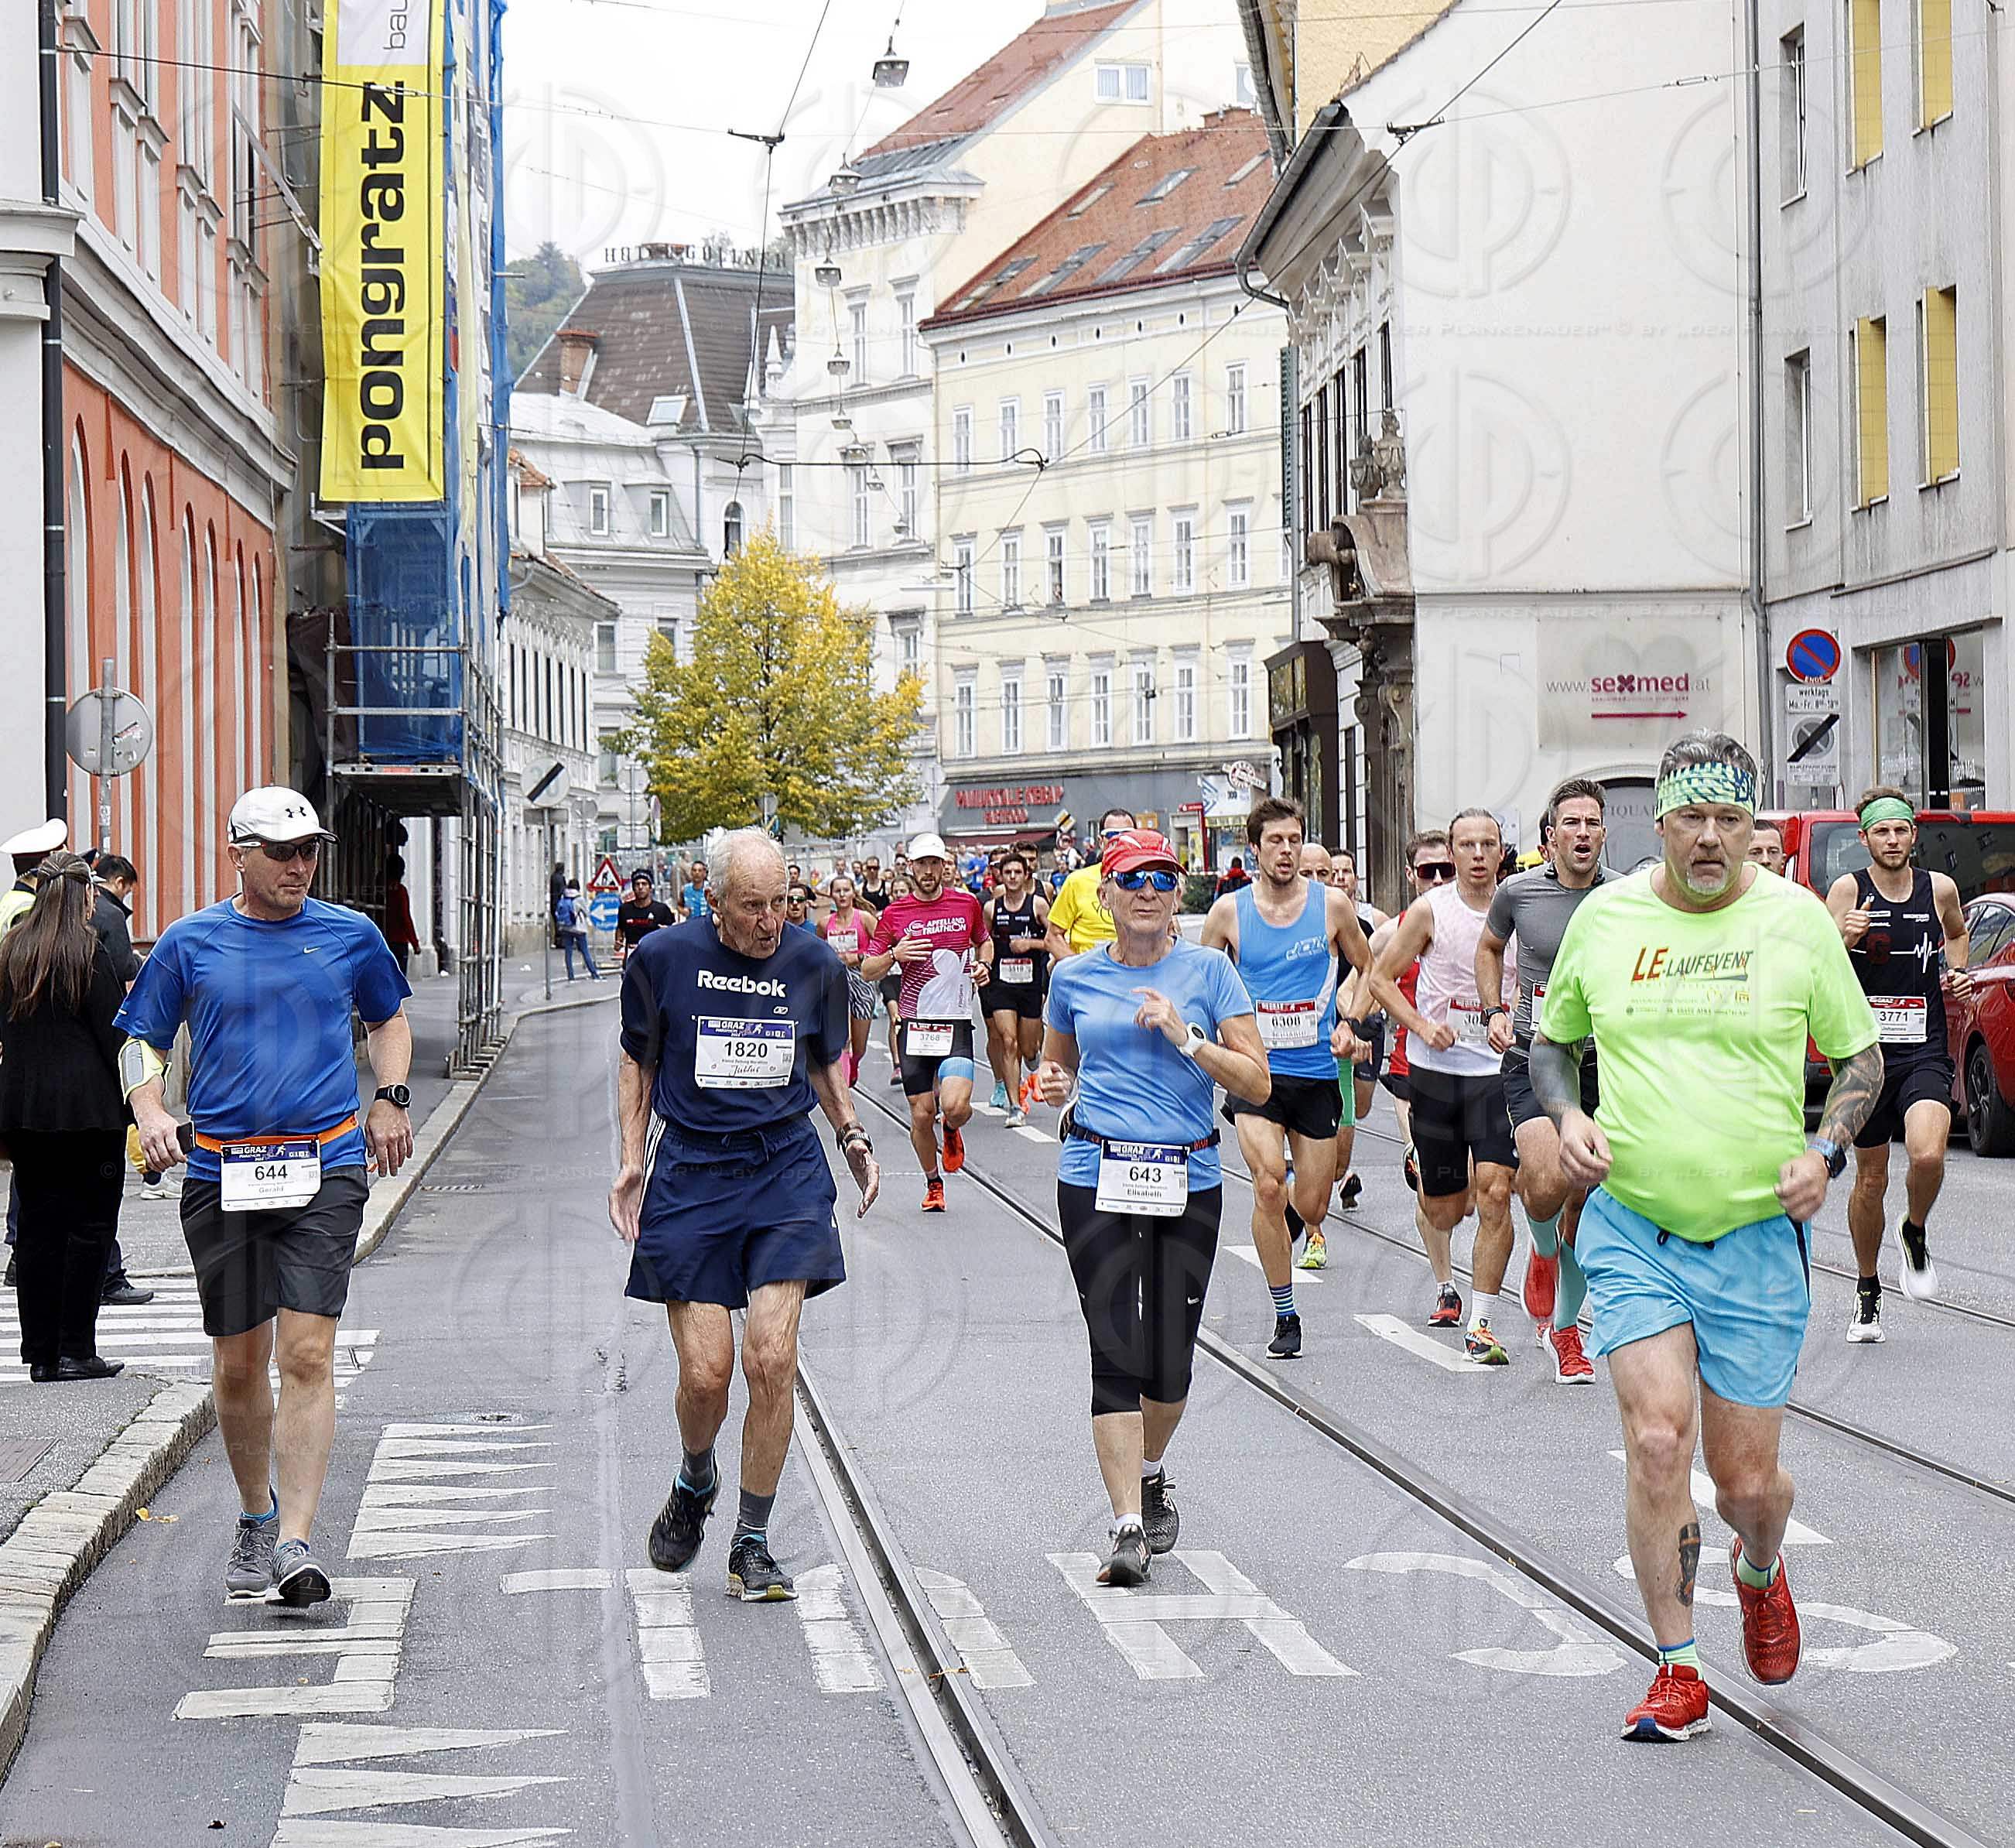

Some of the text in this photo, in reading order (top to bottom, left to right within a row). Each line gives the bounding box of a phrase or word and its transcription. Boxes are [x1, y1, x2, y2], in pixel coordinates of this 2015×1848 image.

[359, 80, 405, 470] pongratz
[1798, 689, 1829, 698] werktags
[926, 917, 965, 927] APFELLAND
[922, 923, 966, 936] TRIATHLON
[697, 970, 786, 998] Reebok
[1880, 1011, 1908, 1022] 3771
[721, 1021, 746, 1030] GRAZ
[919, 1033, 940, 1042] 3768
[724, 1041, 768, 1058] 1820
[255, 1164, 288, 1181] 644
[1130, 1166, 1161, 1182] 643
[1127, 1188, 1162, 1198] Elisabeth
